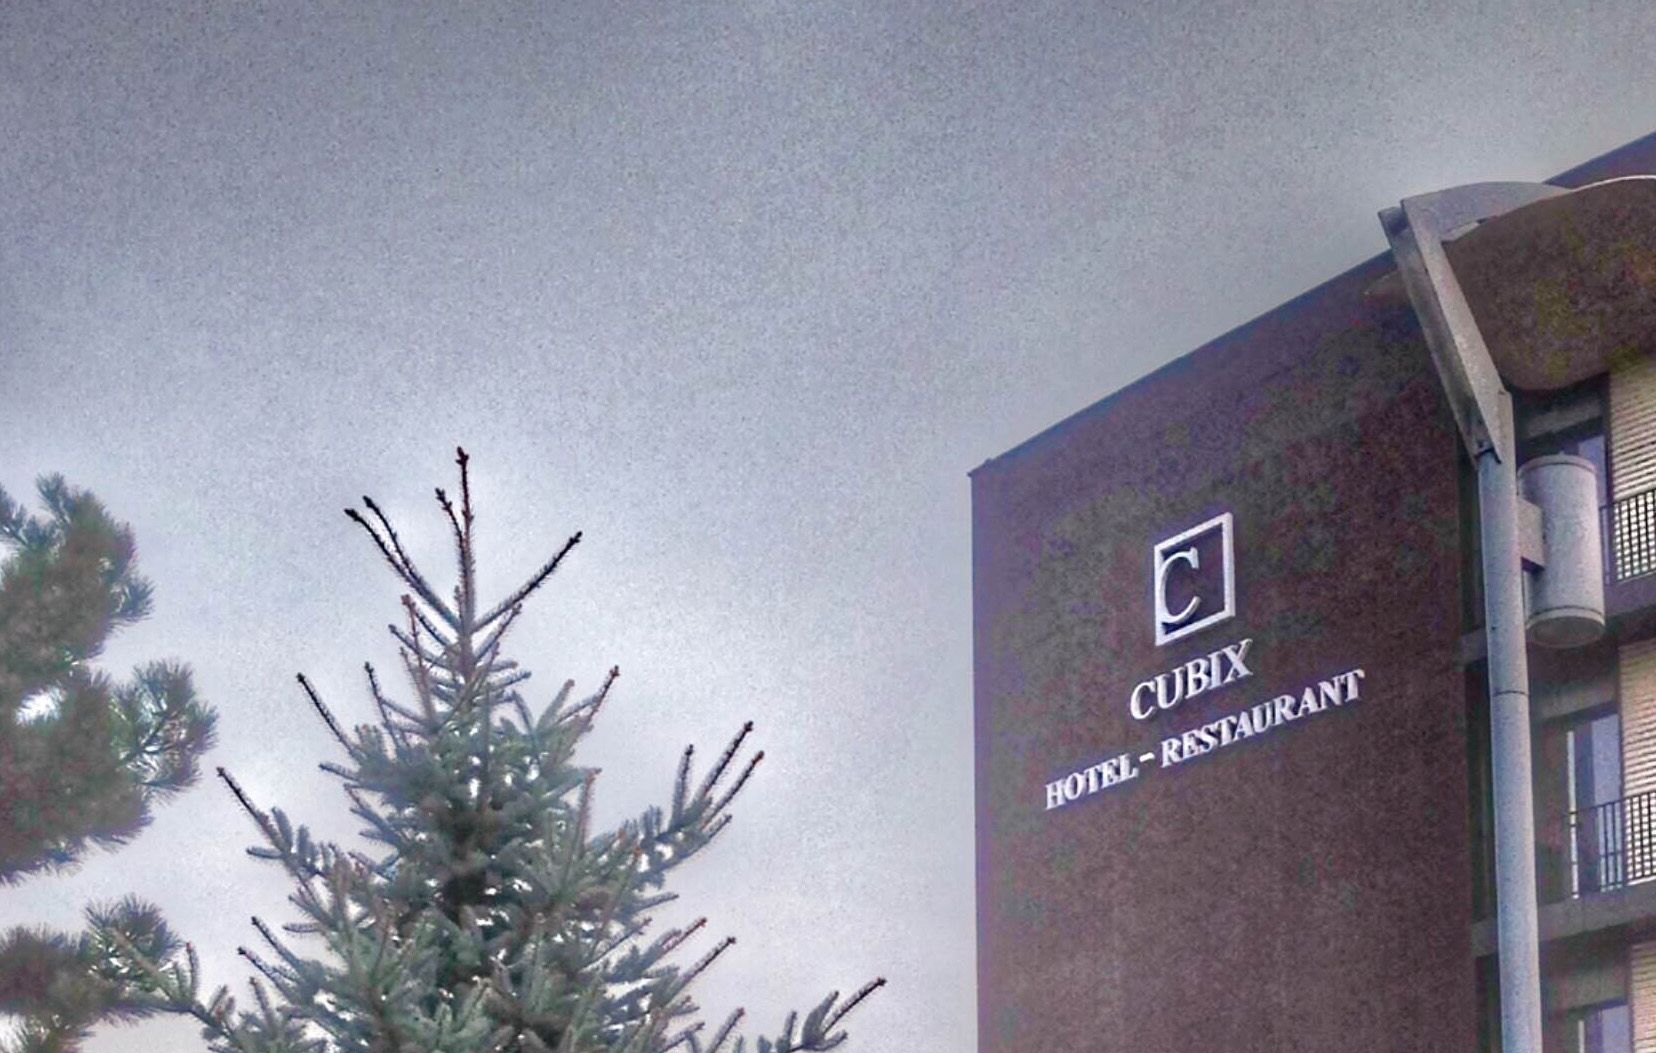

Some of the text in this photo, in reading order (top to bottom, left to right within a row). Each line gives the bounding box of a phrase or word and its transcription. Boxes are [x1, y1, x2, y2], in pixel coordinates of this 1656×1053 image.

[1129, 638, 1254, 721] CUBIX
[1044, 753, 1140, 811] HOTEL
[1160, 668, 1366, 769] RESTAURANT
